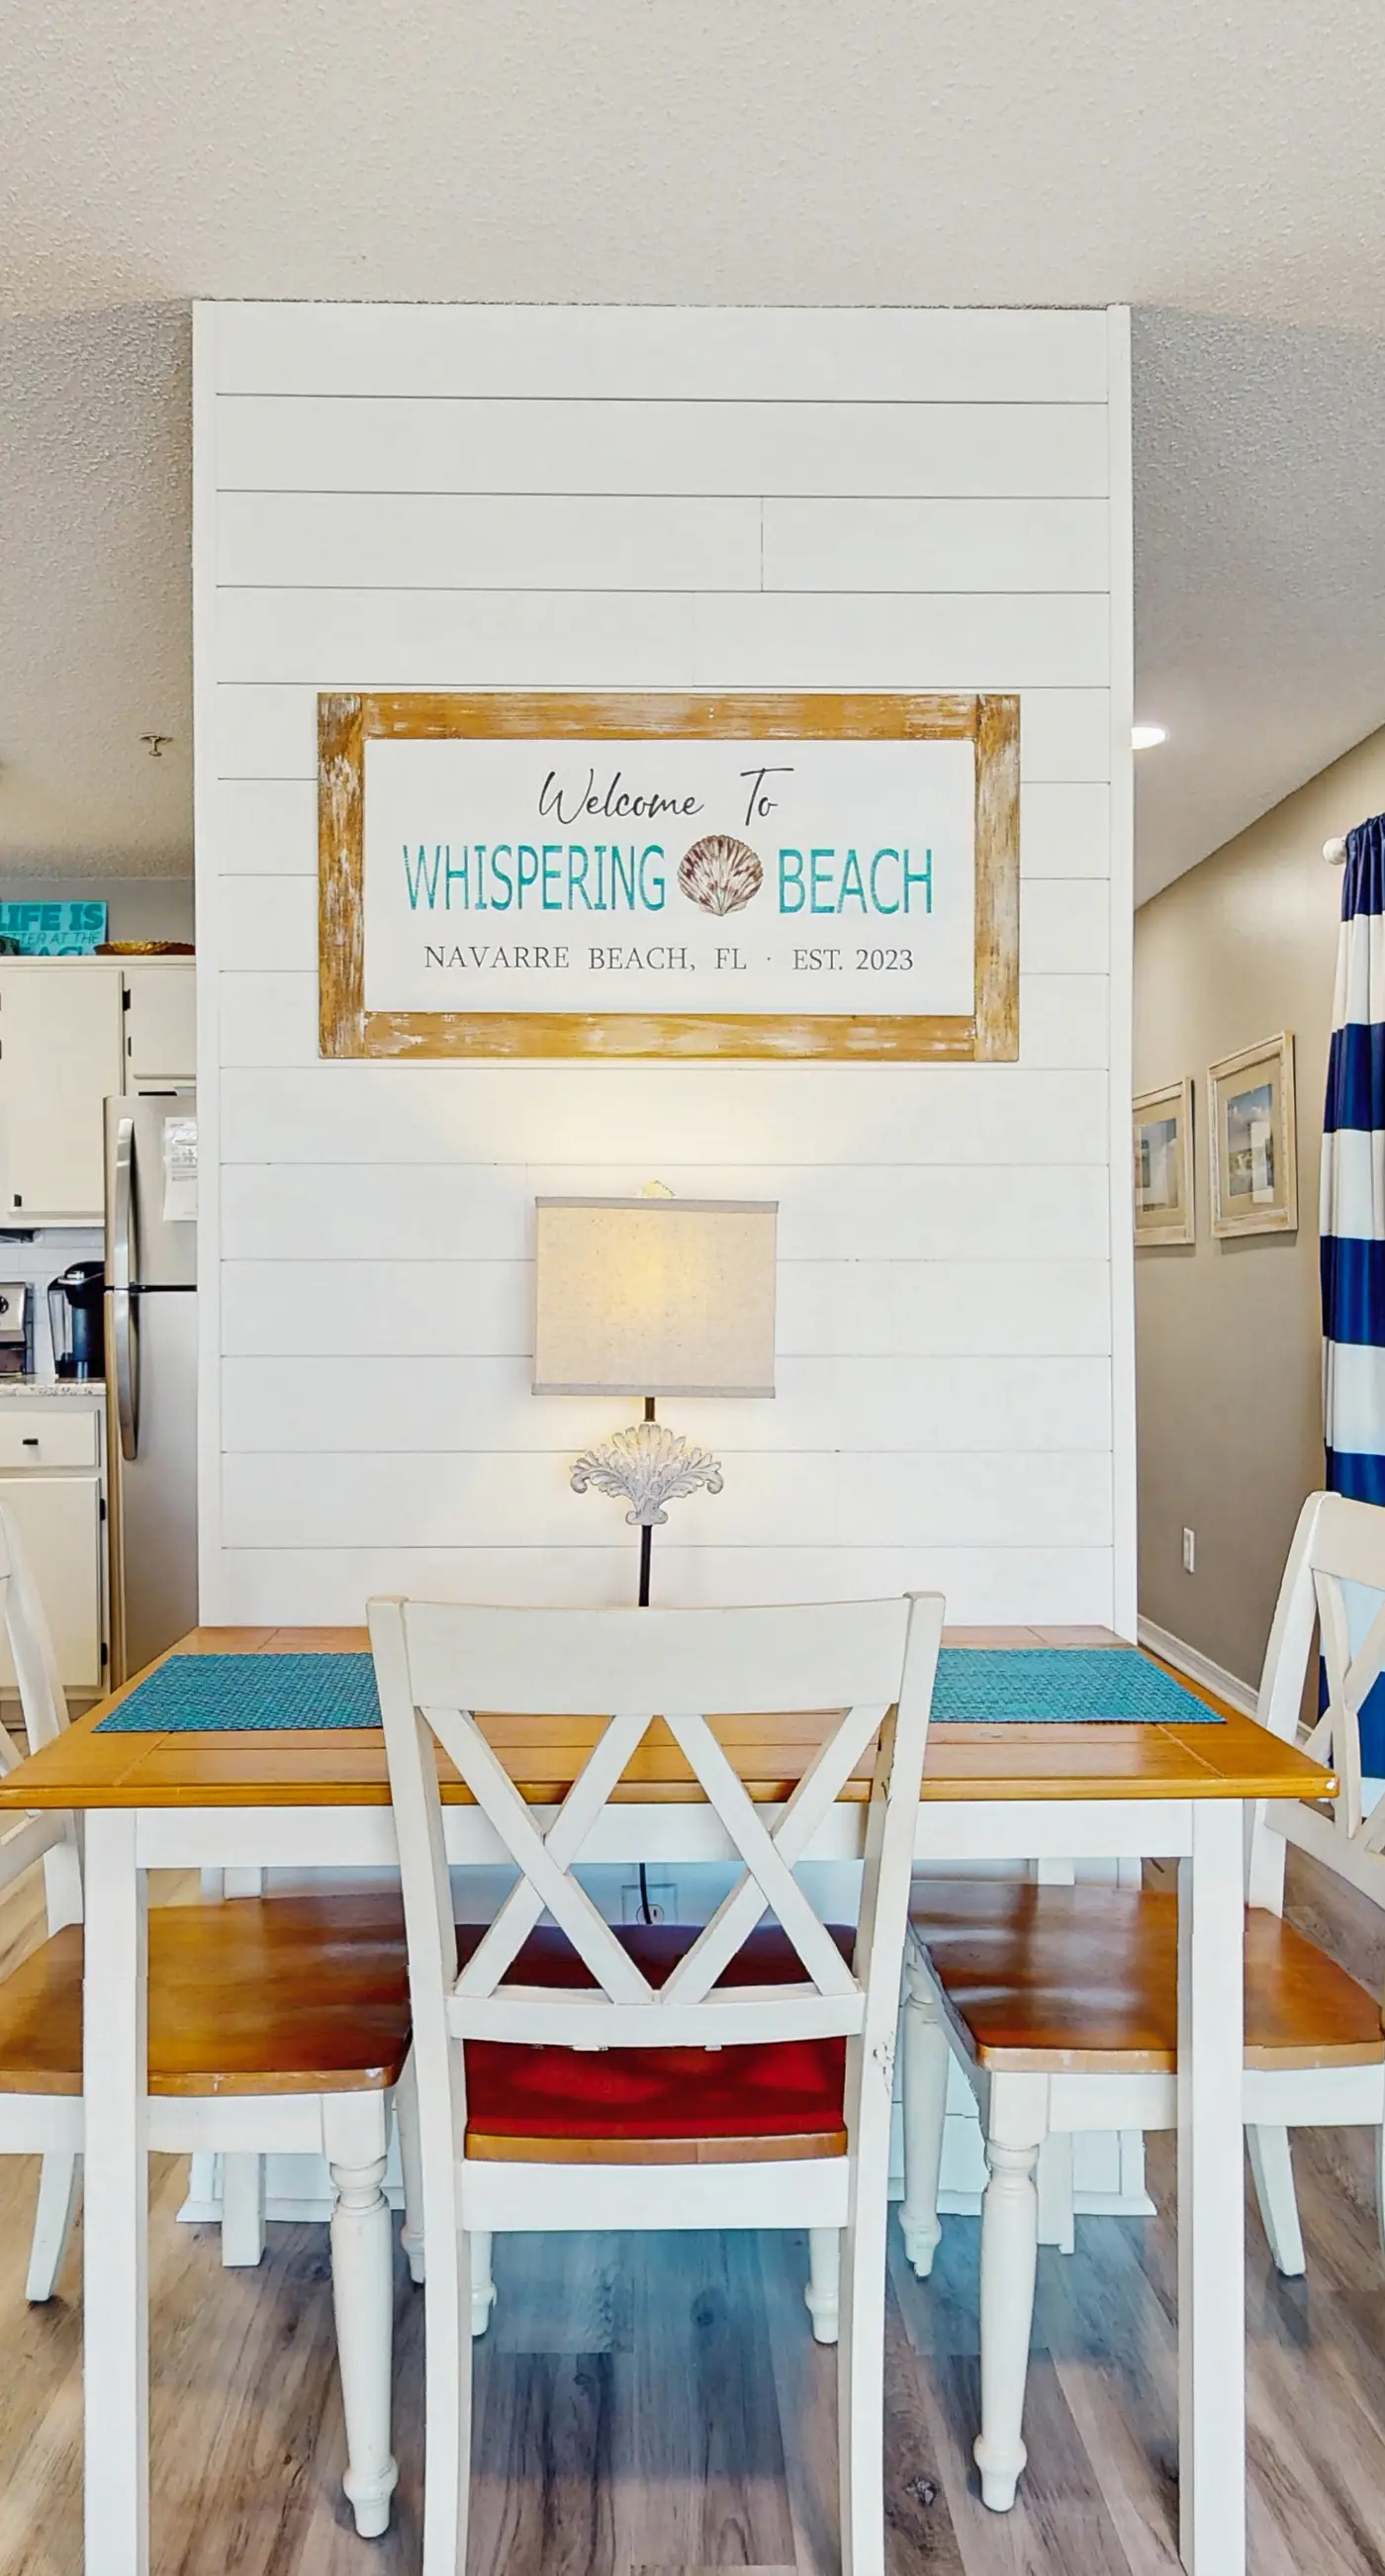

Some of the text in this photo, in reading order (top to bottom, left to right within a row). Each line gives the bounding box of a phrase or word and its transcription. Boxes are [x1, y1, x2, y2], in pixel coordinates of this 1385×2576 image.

[539, 767, 795, 827] Welcome To
[402, 844, 933, 915] WHISPERING BEACH
[69, 903, 104, 931] IS
[50, 932, 69, 945] AT
[74, 932, 100, 944] THE
[423, 946, 914, 972] NAVARRE BEACH, FL EST. 2023
